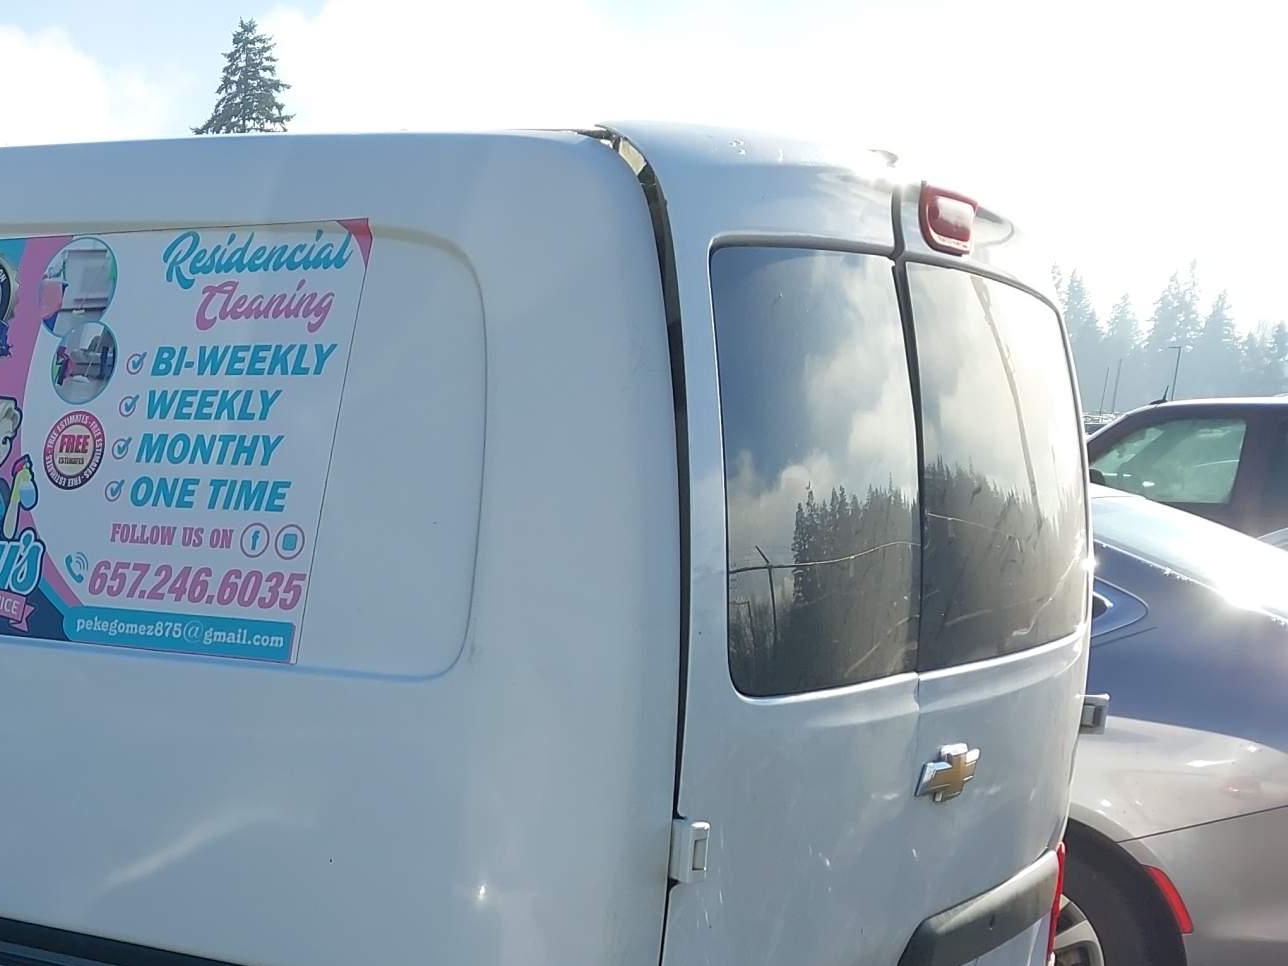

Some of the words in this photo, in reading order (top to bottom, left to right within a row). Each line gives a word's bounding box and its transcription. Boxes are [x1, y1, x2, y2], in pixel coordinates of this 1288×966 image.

[163, 229, 353, 290] Residencial
[196, 279, 335, 333] Cleaning
[151, 344, 337, 376] BI-WEEKLY
[146, 389, 282, 421] WEEKLY
[59, 434, 90, 453] FREE
[135, 433, 284, 466] MONTHY
[130, 476, 200, 508] ONE
[207, 479, 291, 512] TIME
[110, 523, 177, 547] FOLLOW
[181, 527, 204, 547] US
[209, 529, 233, 549] ON
[88, 560, 306, 610] 657.246.6035
[76, 616, 284, 648] pekegomez875@gmail.com
